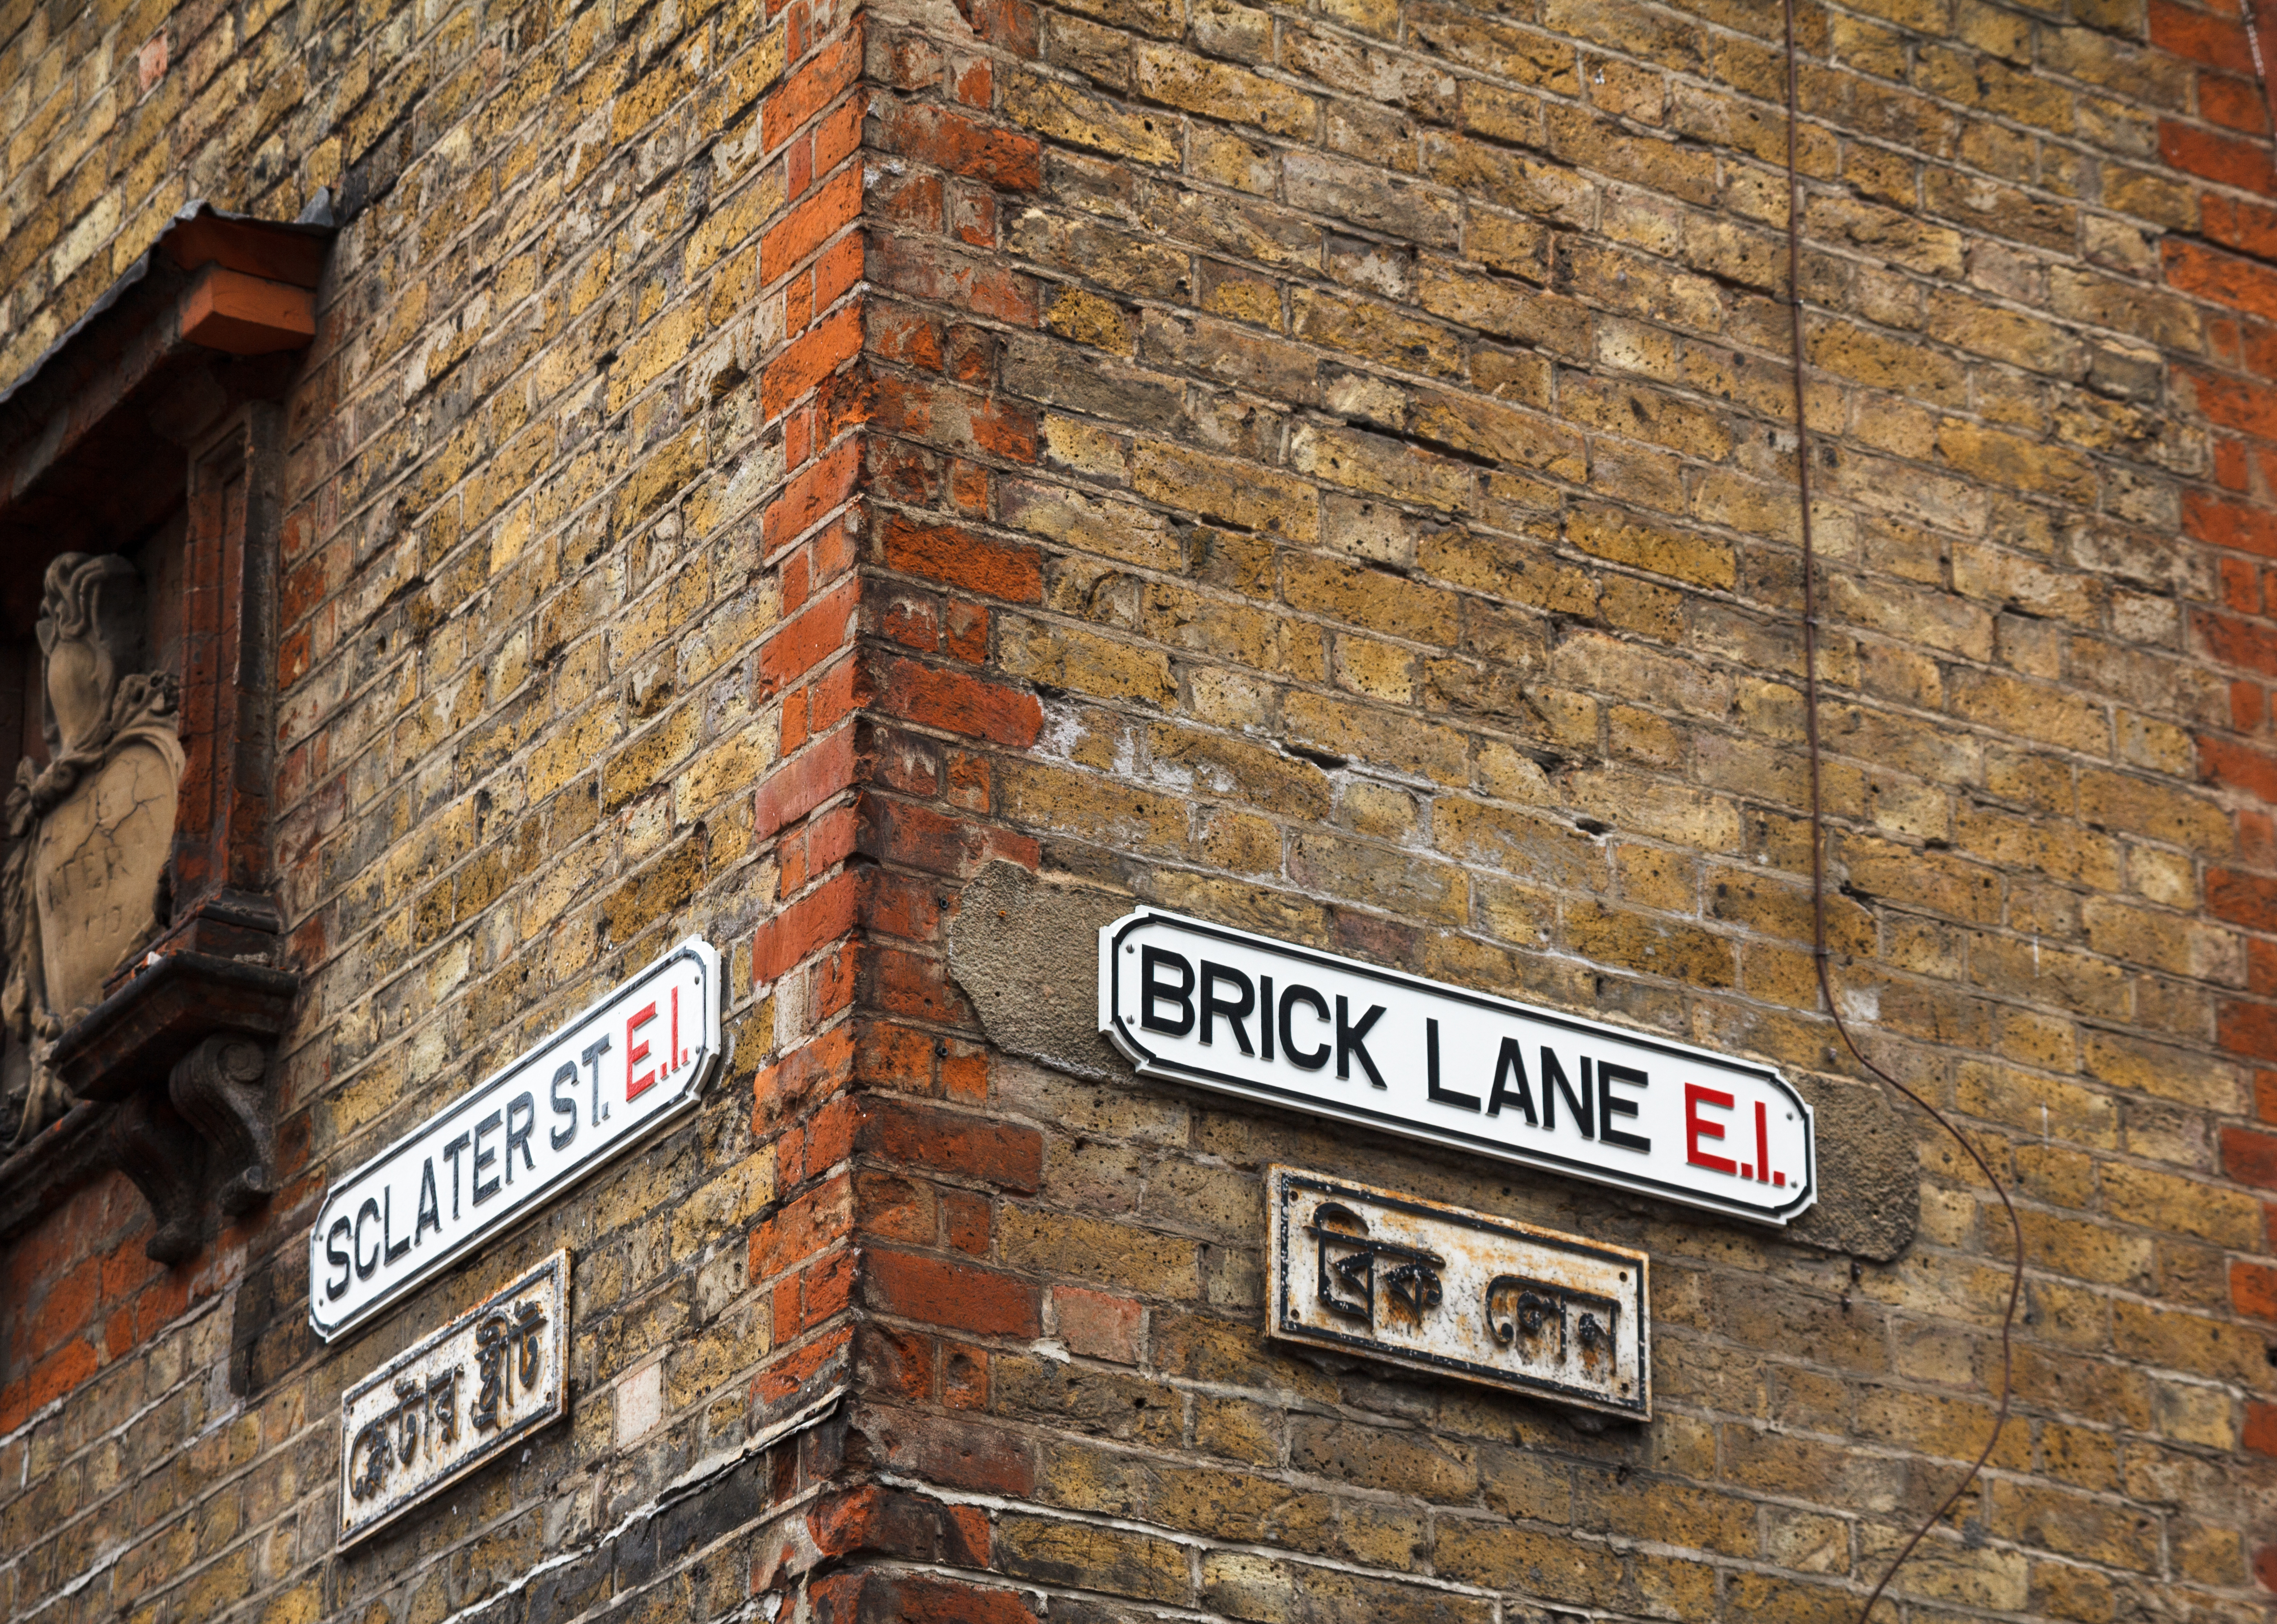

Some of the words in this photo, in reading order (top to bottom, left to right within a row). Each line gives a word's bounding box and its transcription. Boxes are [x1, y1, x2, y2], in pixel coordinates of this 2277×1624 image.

[1140, 943, 1387, 1089] BRICK
[1425, 1017, 1651, 1152] LANE
[326, 1091, 535, 1301] SCLATER
[549, 1034, 612, 1150] ST.
[1303, 1202, 1447, 1332] ব্রিক
[1485, 1274, 1621, 1376] লেন
